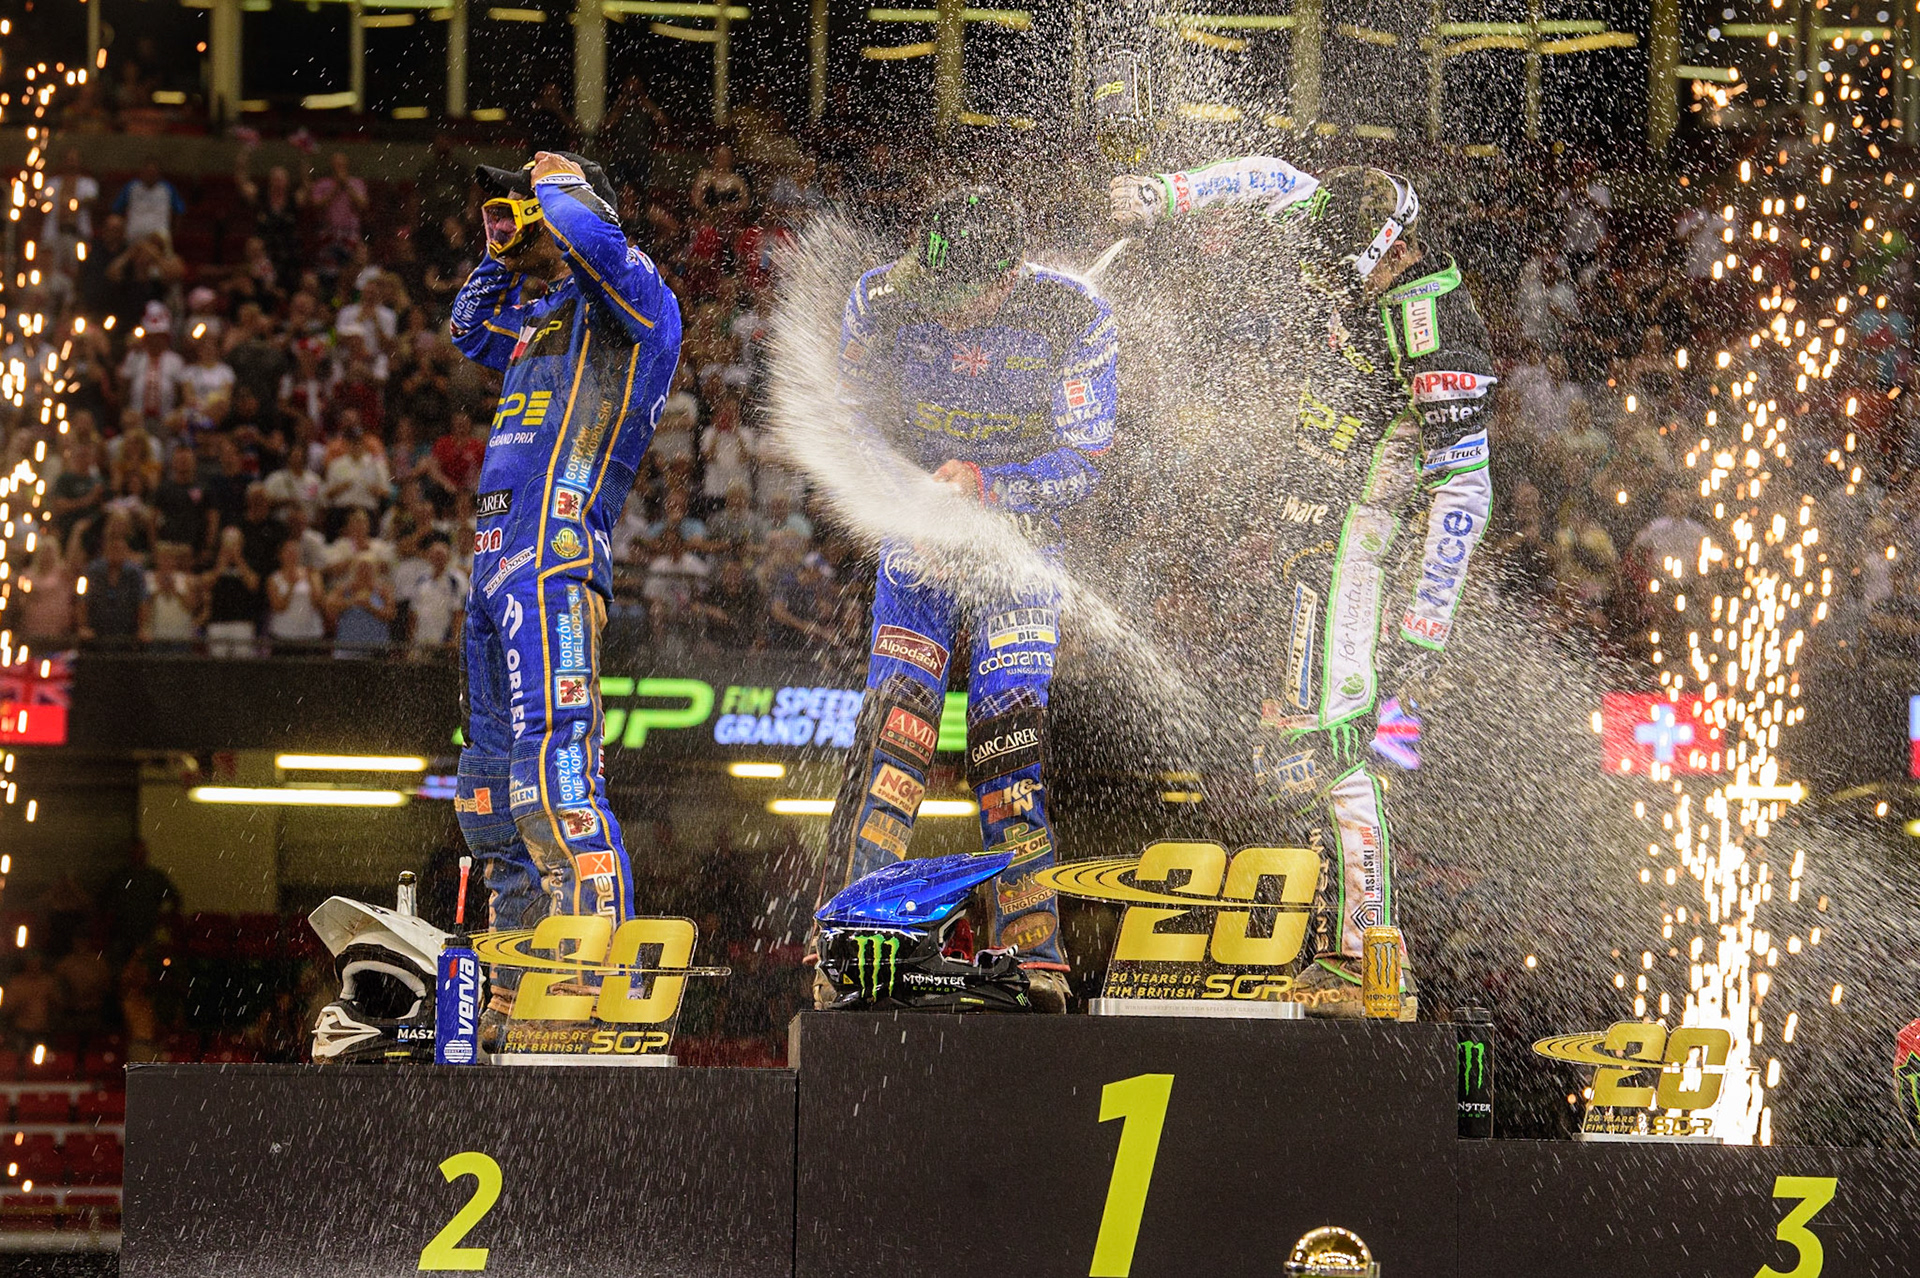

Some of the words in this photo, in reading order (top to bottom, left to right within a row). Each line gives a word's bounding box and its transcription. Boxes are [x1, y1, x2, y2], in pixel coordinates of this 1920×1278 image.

[513, 431, 537, 444] PRIX
[1450, 446, 1482, 460] Truck
[477, 493, 509, 514] AREK
[1417, 511, 1473, 607] Nice
[557, 614, 573, 667] GORZÓW
[879, 638, 938, 671] Alpodach
[979, 651, 1053, 676] colorama
[1288, 646, 1305, 698] Truck
[889, 712, 935, 749] AMD
[972, 728, 1038, 762] GARCAREK
[556, 749, 573, 801] GORZÓW
[880, 769, 923, 804] NGK
[1029, 837, 1050, 851] OIL
[1115, 842, 1320, 965] 20
[511, 914, 695, 1023] 20
[903, 973, 965, 986] MONSTER
[1111, 973, 1128, 983] 20
[1132, 973, 1177, 984] YEARS
[1183, 975, 1200, 985] OF
[1107, 986, 1132, 997] FIM
[1137, 987, 1196, 998] BRITISH
[1201, 974, 1293, 999] SGP
[504, 1042, 526, 1052] FIM
[531, 1043, 583, 1053] BRITISH
[528, 1031, 566, 1041] YEARS
[588, 1031, 669, 1054] SGP
[1089, 1073, 1175, 1278] 1
[418, 1151, 503, 1270] 2
[1754, 1176, 1838, 1278] 3
